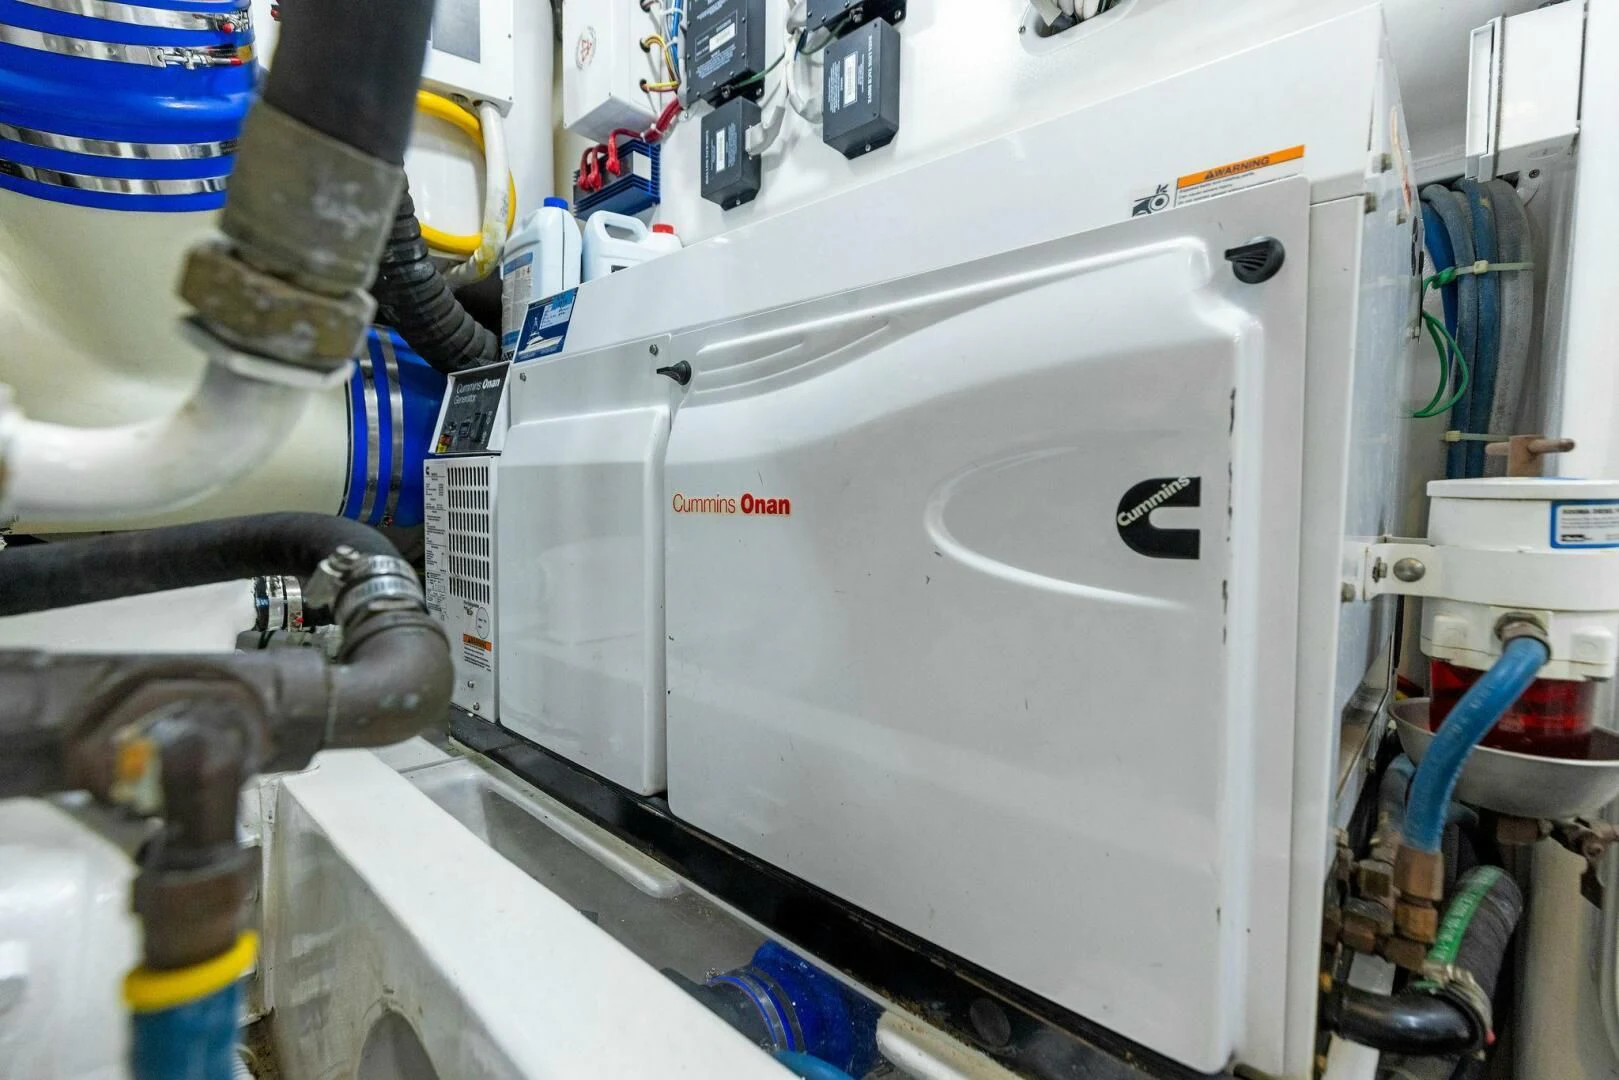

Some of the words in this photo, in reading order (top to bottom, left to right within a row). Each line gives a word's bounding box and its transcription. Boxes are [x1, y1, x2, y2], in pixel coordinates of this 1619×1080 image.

[1213, 156, 1270, 178] WARNING
[456, 382, 482, 394] Cummins
[482, 379, 501, 389] Onan
[672, 493, 736, 514] Cummins
[740, 493, 791, 515] Onan
[1117, 475, 1191, 526] Cummins
